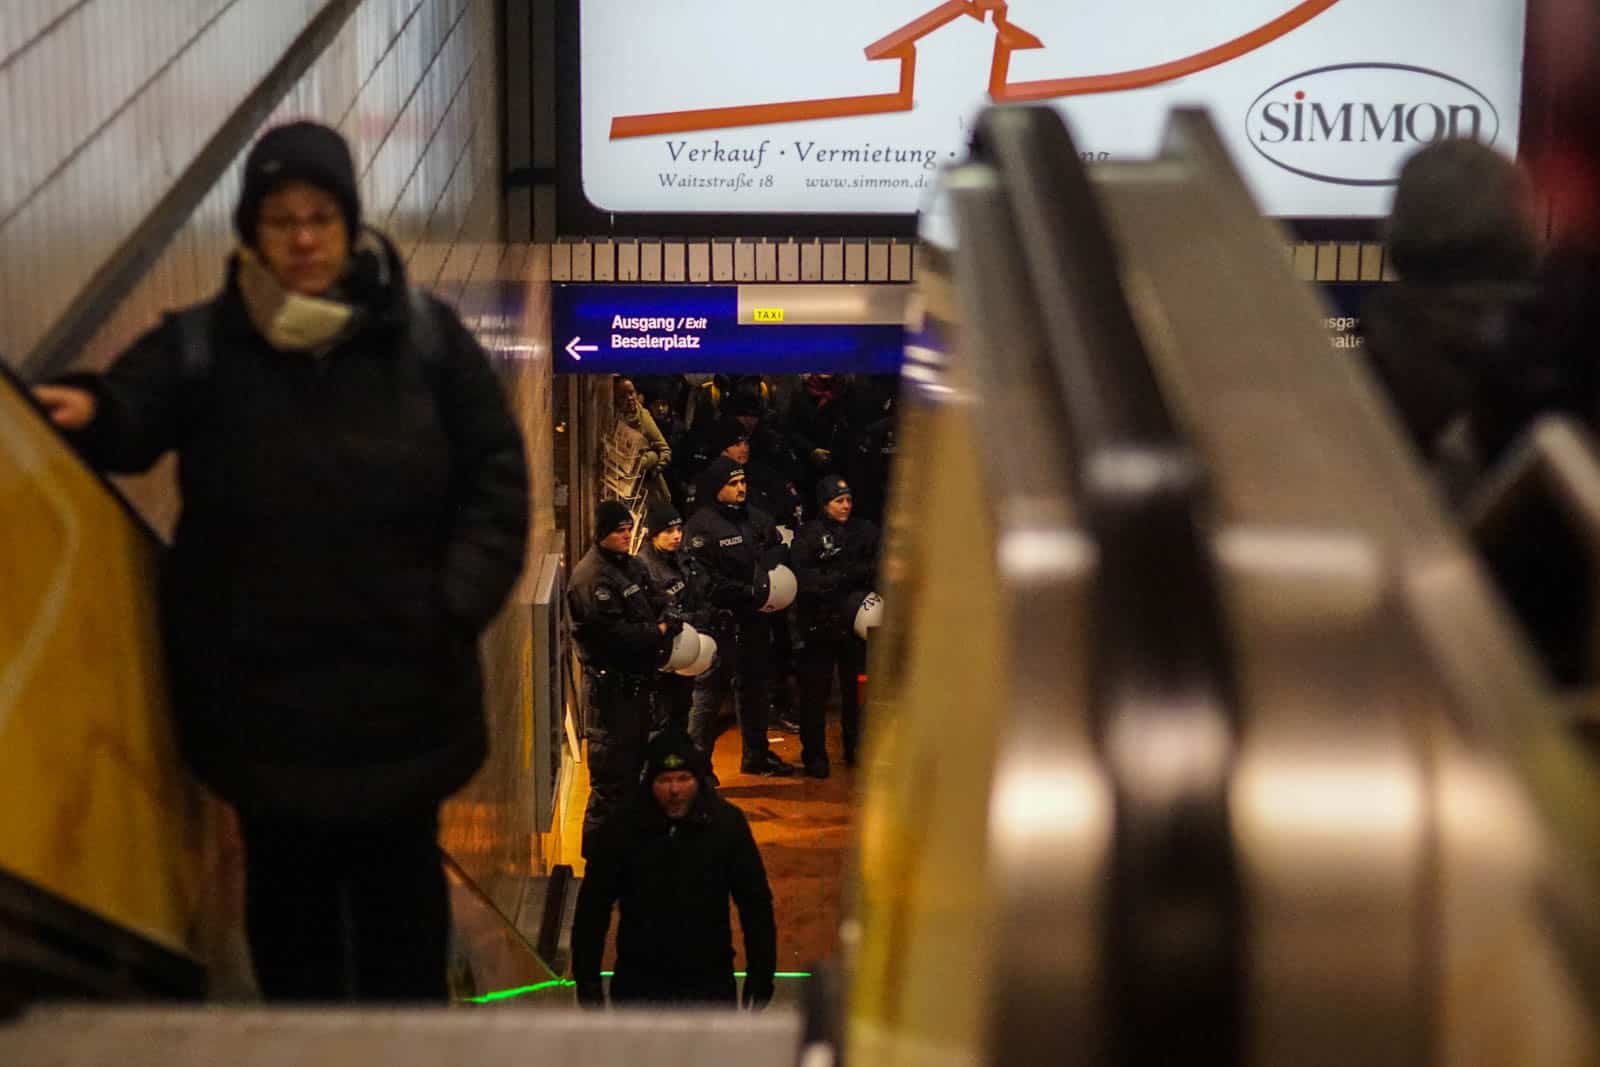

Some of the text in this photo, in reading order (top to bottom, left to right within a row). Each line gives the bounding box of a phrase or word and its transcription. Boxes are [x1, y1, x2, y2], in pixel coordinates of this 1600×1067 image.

[665, 139, 771, 169] Verkauf
[794, 141, 937, 169] Vermietung
[658, 172, 774, 191] Waitzstraße 18
[611, 314, 675, 332] Ausgang
[757, 310, 782, 321] TAXI
[611, 334, 700, 351] Beselerplatz
